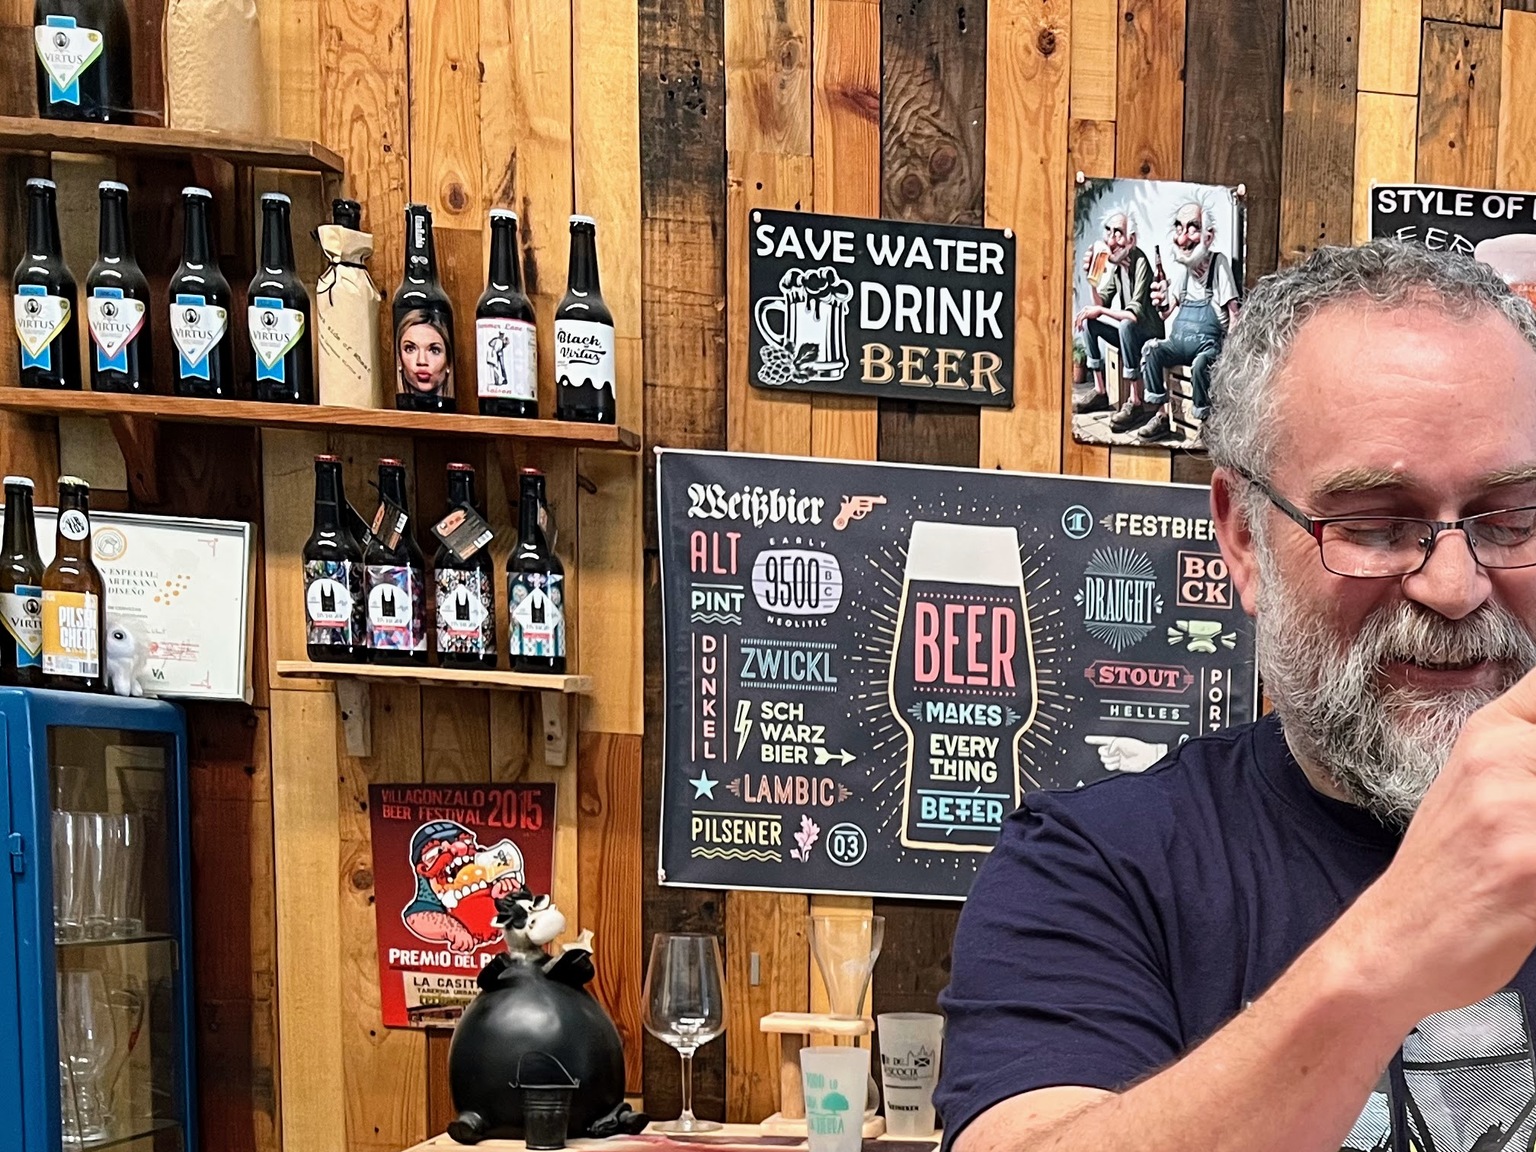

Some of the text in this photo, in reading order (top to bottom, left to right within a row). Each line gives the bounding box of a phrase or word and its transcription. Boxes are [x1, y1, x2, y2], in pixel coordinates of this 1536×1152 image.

[44, 53, 83, 64] VIRTUS
[1377, 189, 1474, 217] STYLE
[1482, 195, 1523, 220] OF
[755, 224, 1005, 275] SAVE WATER
[859, 281, 1004, 339] DRINK
[18, 319, 55, 330] VIRTUS
[93, 321, 131, 332] VIRTUS
[175, 329, 213, 340] VIRTUS
[253, 330, 290, 342] VIRTUS
[557, 330, 601, 348] Black
[860, 342, 1006, 396] BEER
[690, 530, 742, 575] ALT
[769, 537, 827, 549] EARLY
[1183, 557, 1226, 580] BO
[108, 577, 158, 588] ARTESANA
[108, 586, 145, 596] DISEÑO
[765, 556, 820, 609] 9500
[1181, 581, 1227, 604] CK
[691, 590, 745, 612] PINT
[1085, 579, 1156, 625] DRAUGHT
[767, 615, 828, 628] NEOLITIC
[914, 602, 1017, 688] BEER
[740, 649, 838, 685] ZWICKL
[1099, 666, 1179, 688] STOUT
[701, 635, 717, 760] DUNKEL
[761, 702, 804, 722] SCH
[926, 701, 1002, 726] MAKES
[1110, 704, 1180, 720] HELLES
[761, 722, 826, 745] WARZ
[761, 743, 808, 765] BIER
[930, 734, 1000, 759] EVERY
[929, 757, 998, 783] THING
[743, 774, 835, 807] LAMBIC
[381, 789, 543, 831] VILLAGONZALO 2015
[382, 804, 486, 826] BEER FESTIVAL
[691, 818, 783, 847] PILSENER
[389, 948, 496, 969] PREMIO DEL P
[413, 977, 481, 989] LA CASIT
